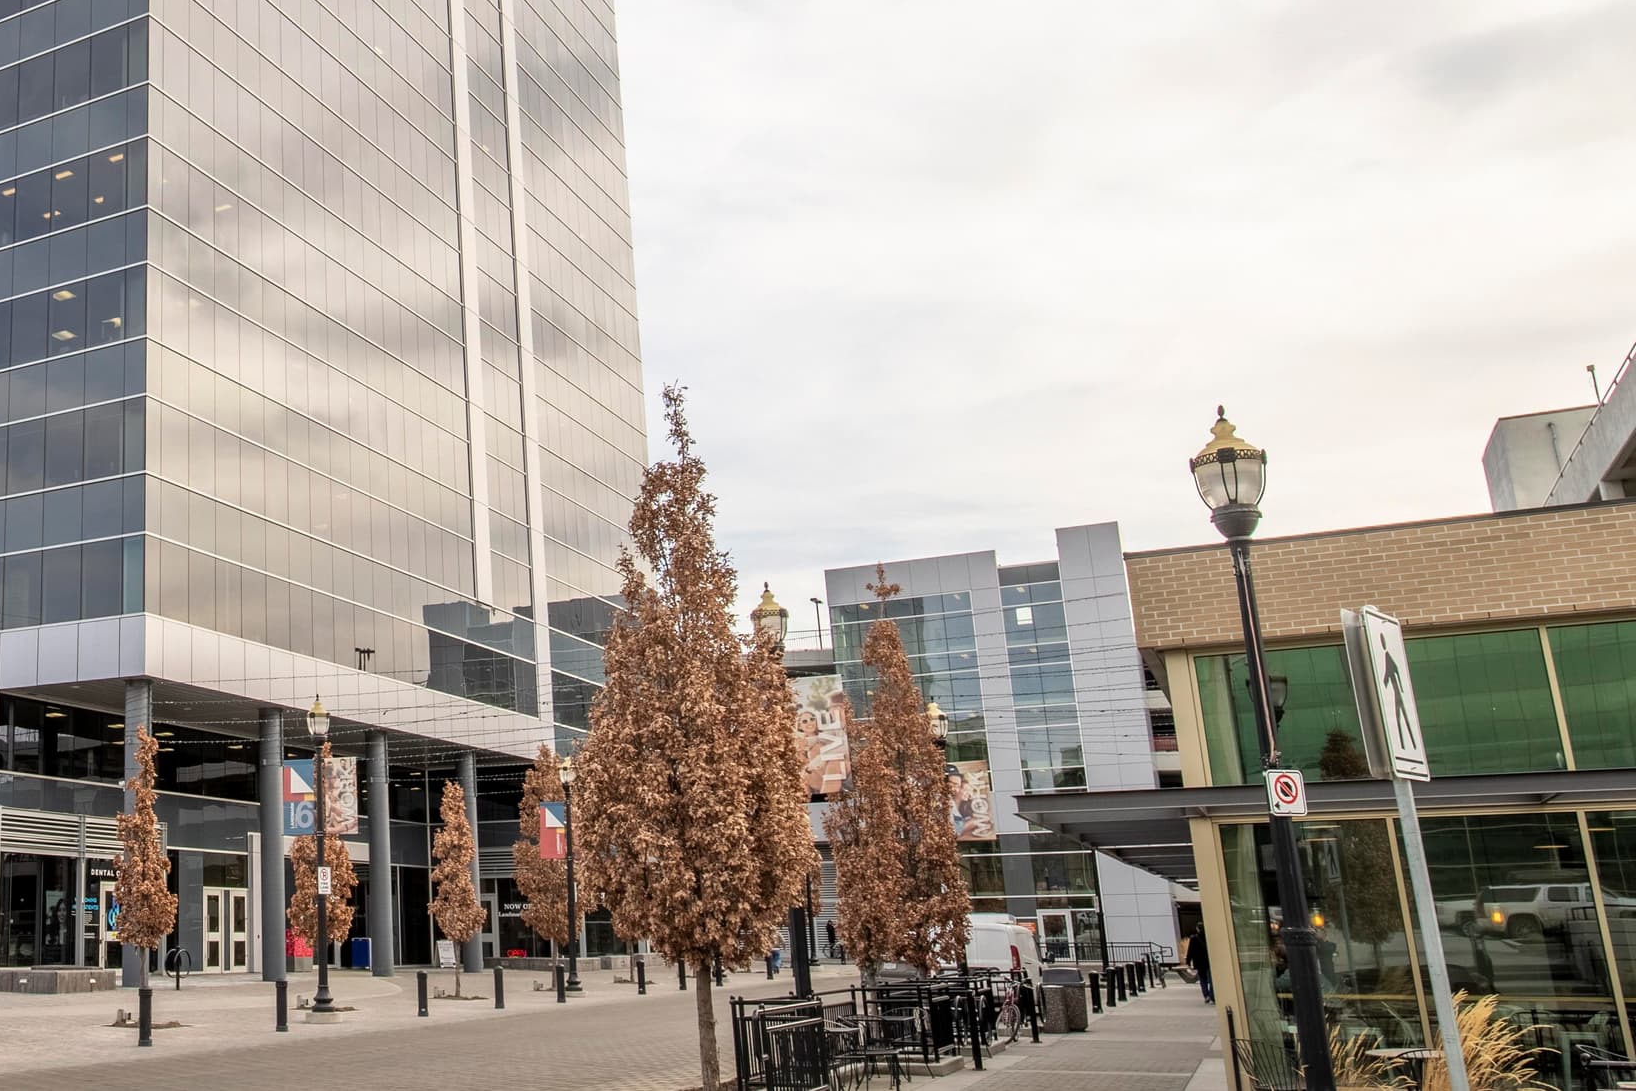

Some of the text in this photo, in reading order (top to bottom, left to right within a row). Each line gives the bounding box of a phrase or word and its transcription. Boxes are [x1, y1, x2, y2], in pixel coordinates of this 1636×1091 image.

[819, 709, 847, 780] LIVE
[296, 801, 315, 828] 6
[90, 869, 114, 877] DENTAL
[507, 949, 527, 958] OPEN
